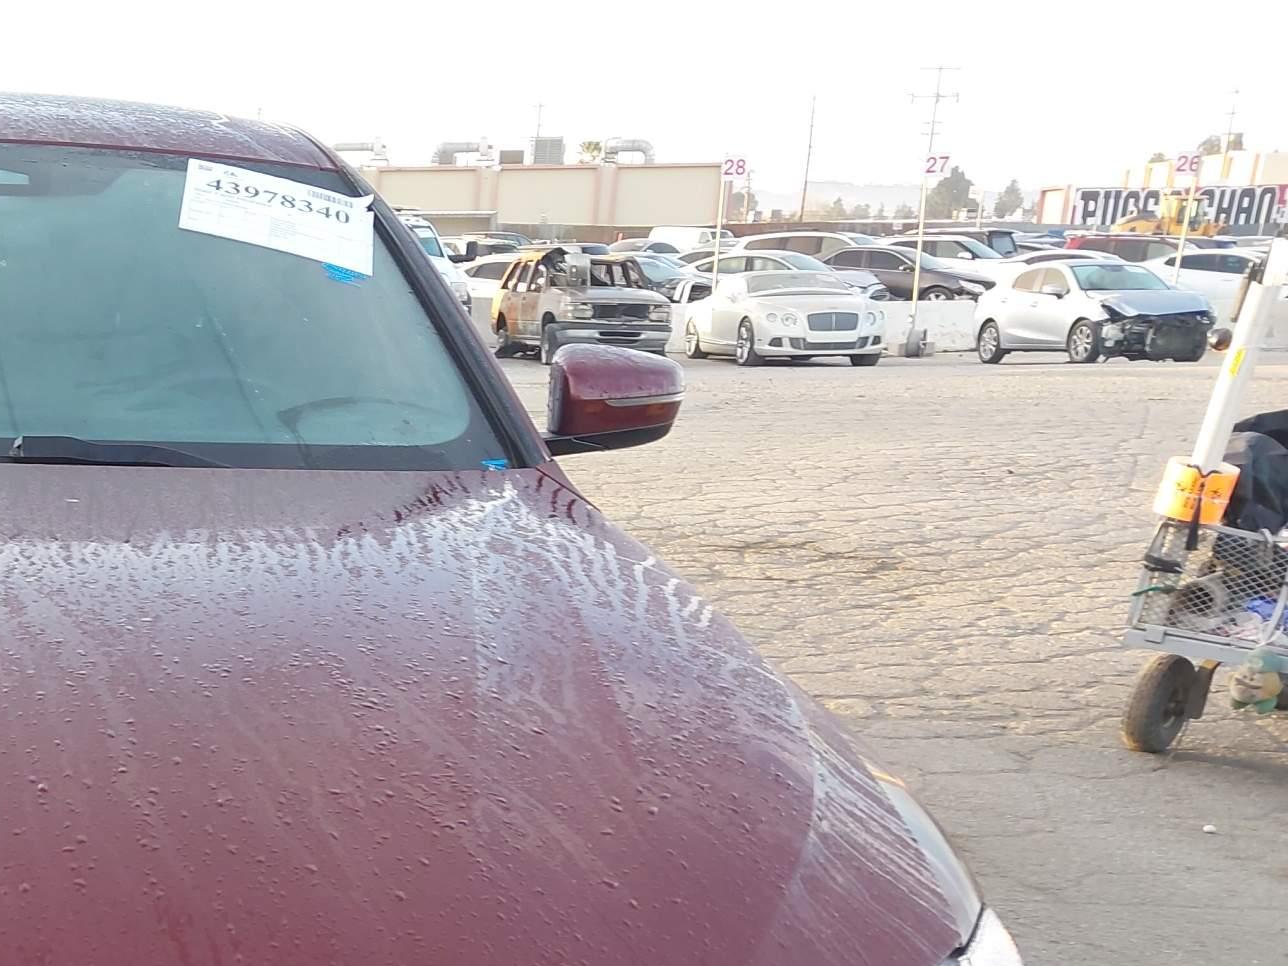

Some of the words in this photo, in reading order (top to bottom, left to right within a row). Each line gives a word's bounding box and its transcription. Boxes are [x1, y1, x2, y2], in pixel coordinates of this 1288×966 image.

[723, 159, 746, 176] 28
[925, 156, 950, 173] 27
[1176, 155, 1201, 172] 26
[206, 179, 350, 224] 43978340
